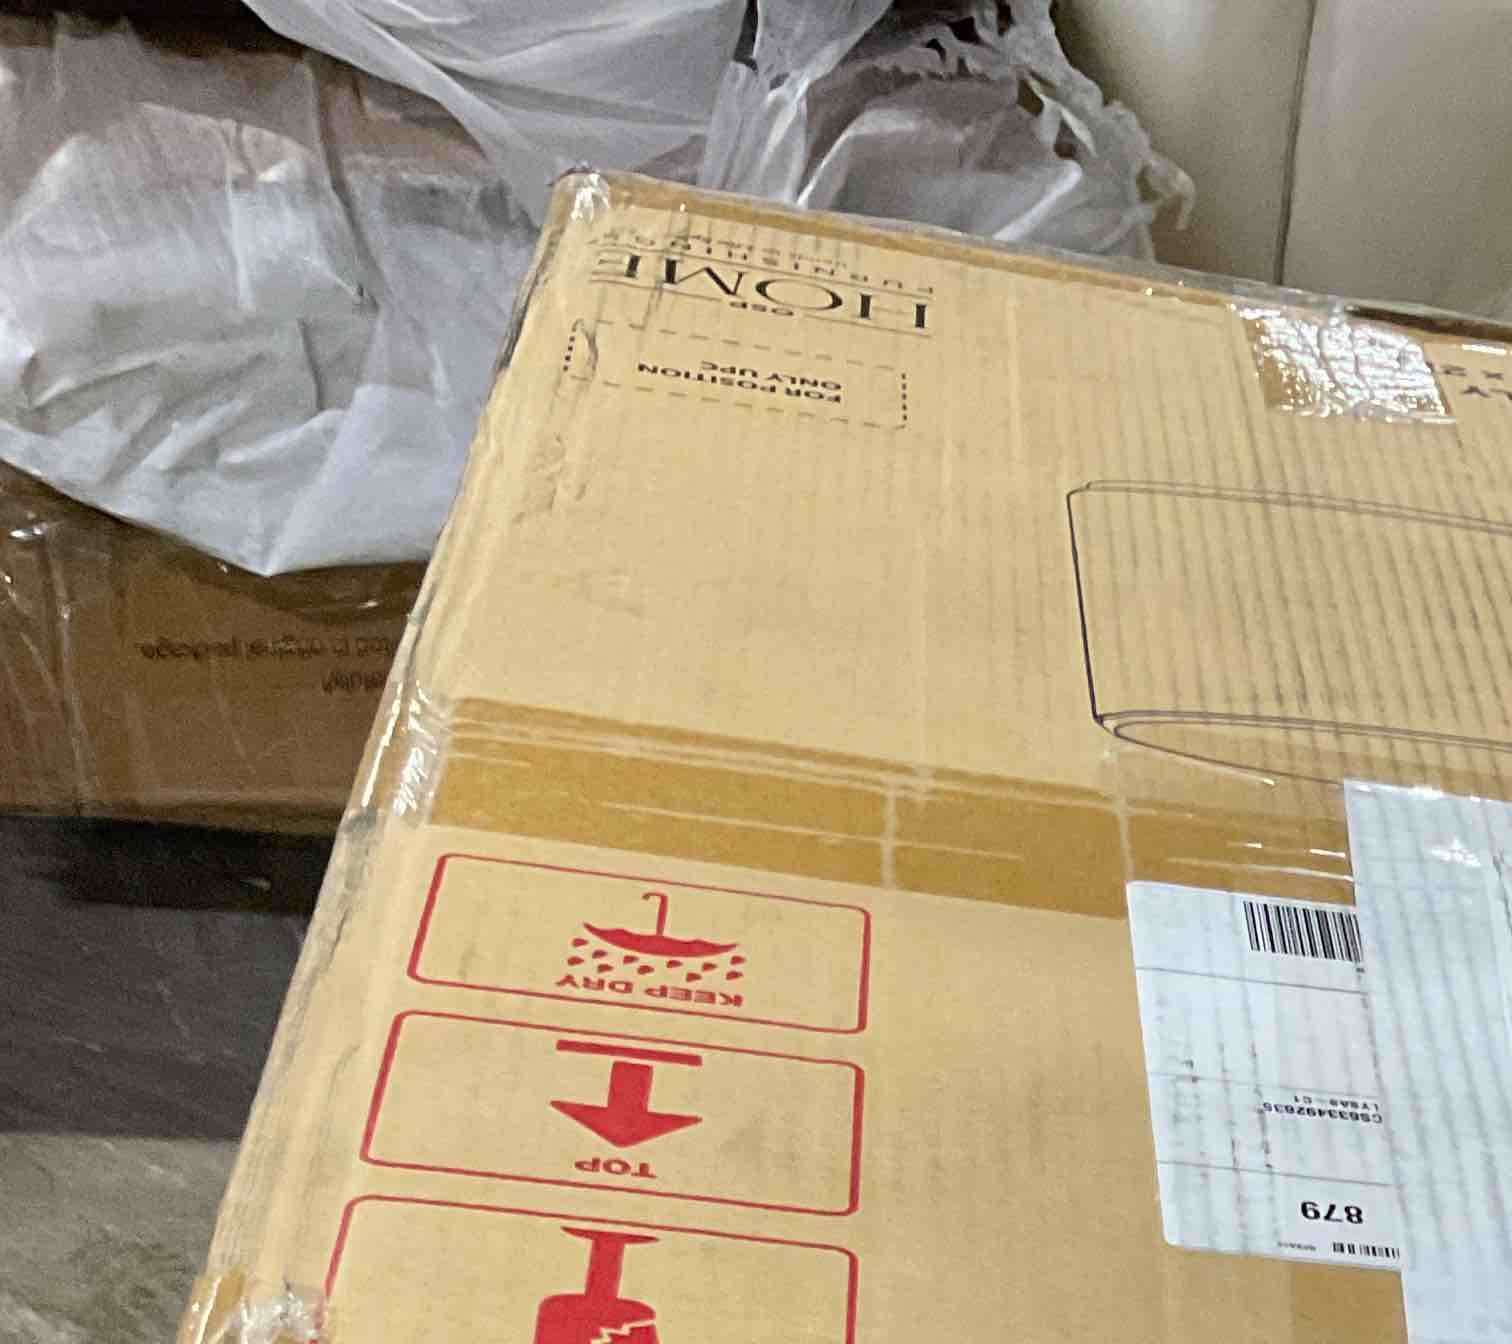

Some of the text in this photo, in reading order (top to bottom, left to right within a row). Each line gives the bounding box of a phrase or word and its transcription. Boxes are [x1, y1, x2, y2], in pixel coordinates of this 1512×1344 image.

[589, 253, 927, 329] HOME
[637, 363, 842, 404] FOR POSITION
[699, 361, 842, 390] ONLY UPC
[555, 975, 743, 1008] KEEP DRY
[575, 1157, 655, 1179] TOP
[1300, 1201, 1363, 1225] 879
